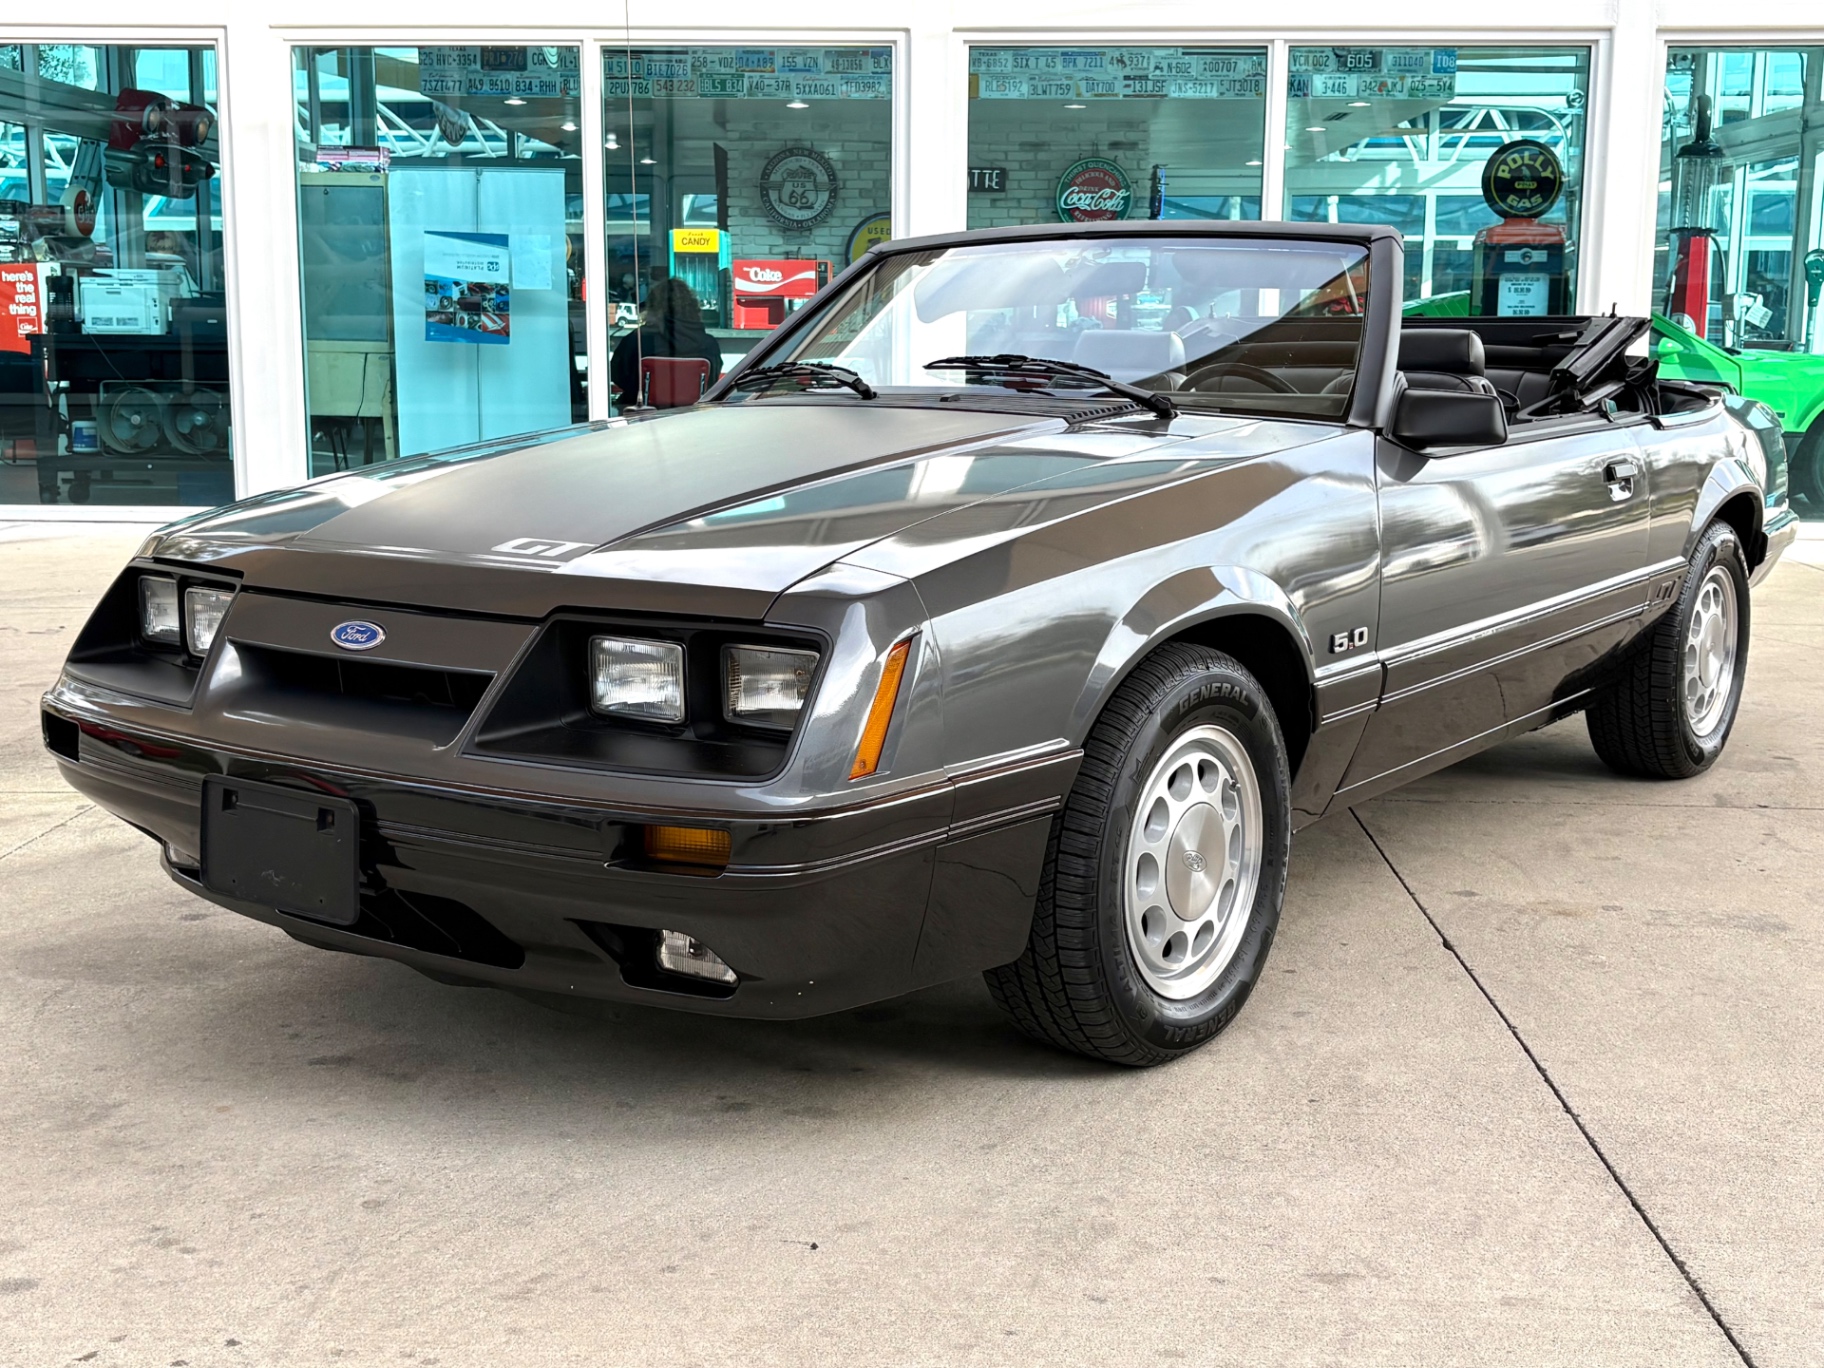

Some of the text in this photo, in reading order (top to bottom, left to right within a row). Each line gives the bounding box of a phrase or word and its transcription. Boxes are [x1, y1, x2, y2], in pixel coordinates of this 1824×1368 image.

[782, 56, 797, 68] 155
[1013, 57, 1030, 69] SIX
[1045, 57, 1057, 68] 45
[1083, 57, 1104, 68] 7211
[1347, 54, 1373, 67] 605
[796, 83, 836, 95] 5XXA061
[1497, 151, 1554, 179] POLLY
[1064, 162, 1127, 187] THIRST QUENCHING
[789, 189, 809, 205] 66
[1061, 186, 1131, 211] Coca-Cola
[1507, 194, 1543, 208] GAS
[681, 237, 711, 246] CANDY
[1, 270, 34, 282] here's
[743, 267, 783, 282] Coke
[16, 282, 34, 293] the
[15, 292, 36, 303] real
[8, 303, 37, 317] thing
[340, 625, 371, 642] Ford
[1329, 626, 1369, 654] 5.0
[1179, 682, 1249, 716] GENERAL
